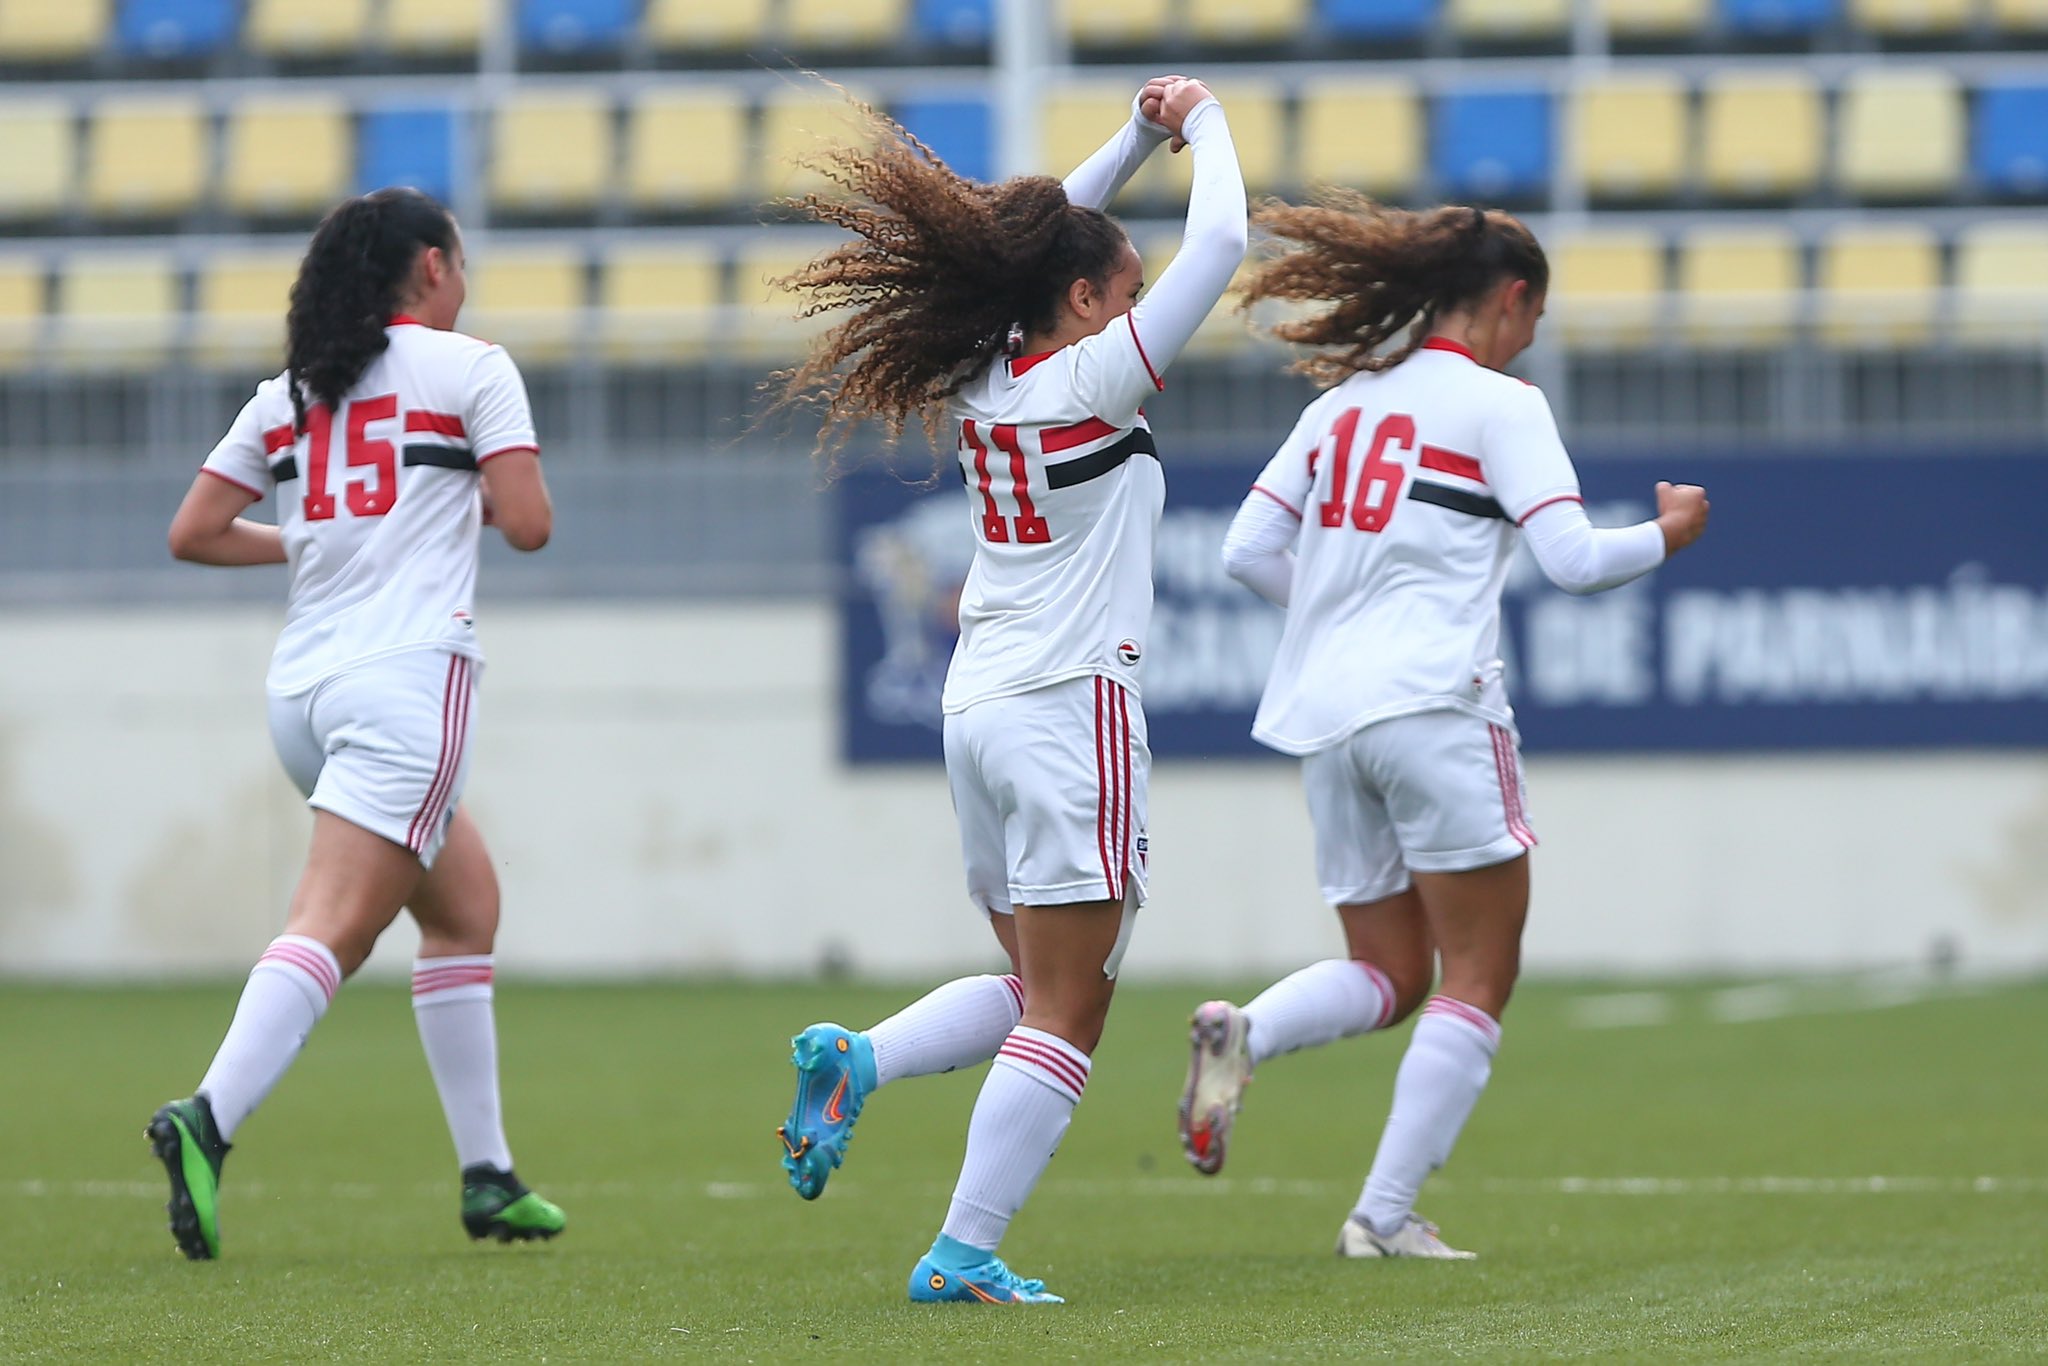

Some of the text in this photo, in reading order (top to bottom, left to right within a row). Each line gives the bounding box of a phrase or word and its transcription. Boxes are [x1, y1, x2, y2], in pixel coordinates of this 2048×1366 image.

[302, 393, 397, 522] 15
[961, 418, 1053, 543] 11
[1319, 406, 1416, 533] 16
